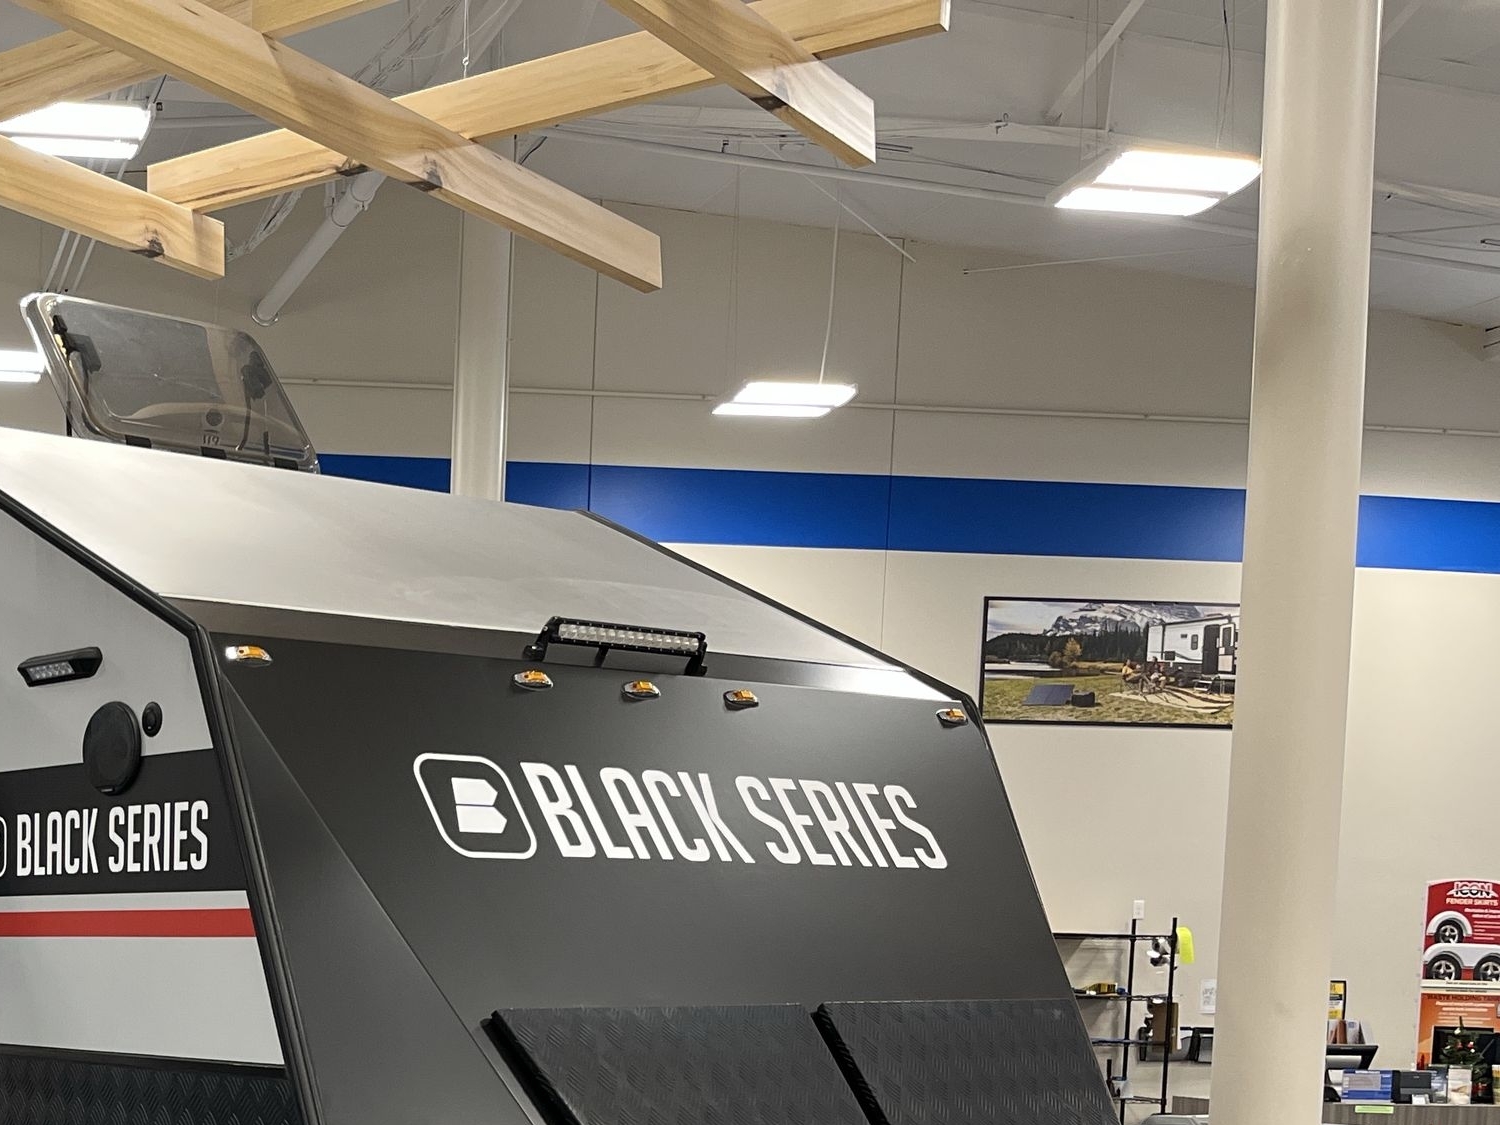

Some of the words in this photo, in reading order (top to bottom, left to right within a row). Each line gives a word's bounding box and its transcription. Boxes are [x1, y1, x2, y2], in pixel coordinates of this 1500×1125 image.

[16, 807, 99, 877] BLACK
[108, 800, 209, 873] SERIES
[520, 761, 756, 864] BLACK
[734, 775, 948, 870] SERIES
[1445, 897, 1474, 905] FENDER
[1474, 898, 1499, 906] SKIRTS
[1453, 881, 1493, 899] ICON
